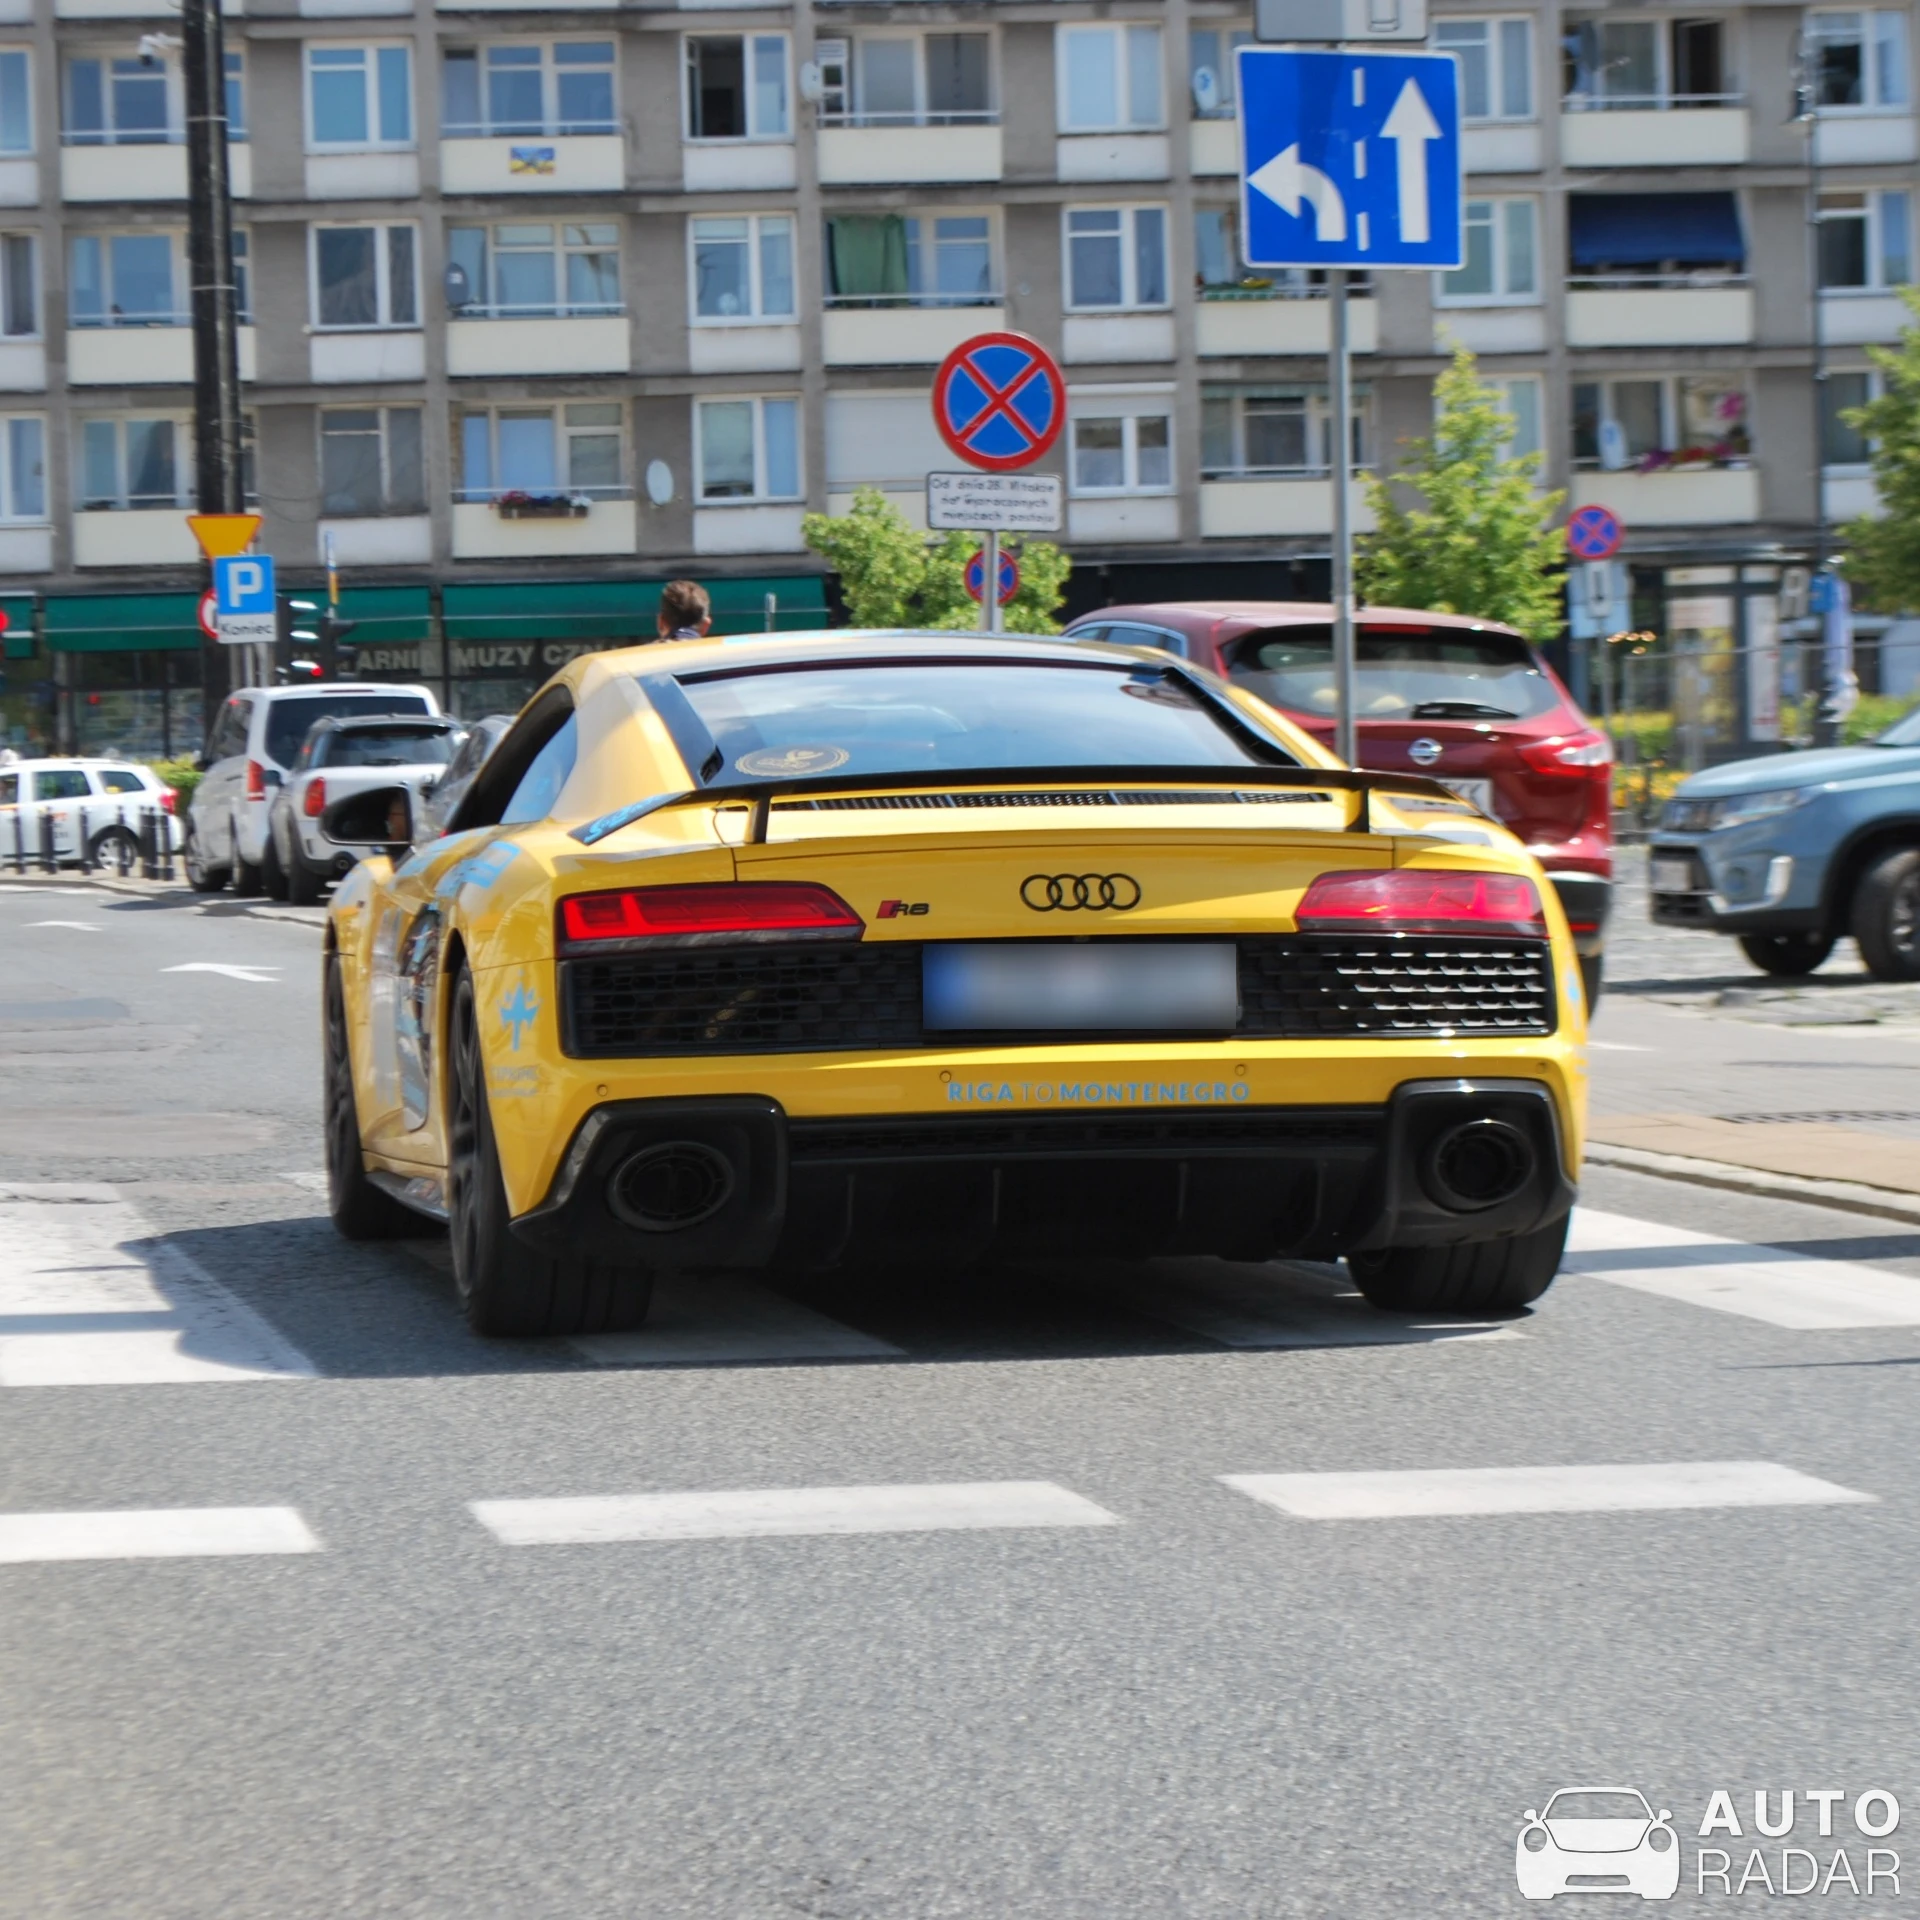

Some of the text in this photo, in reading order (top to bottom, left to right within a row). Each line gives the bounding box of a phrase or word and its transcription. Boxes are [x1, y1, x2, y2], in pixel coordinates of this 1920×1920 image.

[931, 479, 950, 489] Od
[227, 562, 263, 608] P
[220, 621, 273, 636] Koniec
[888, 903, 930, 916] R8
[948, 1082, 1250, 1102] RIGA TO MONTENEGRO
